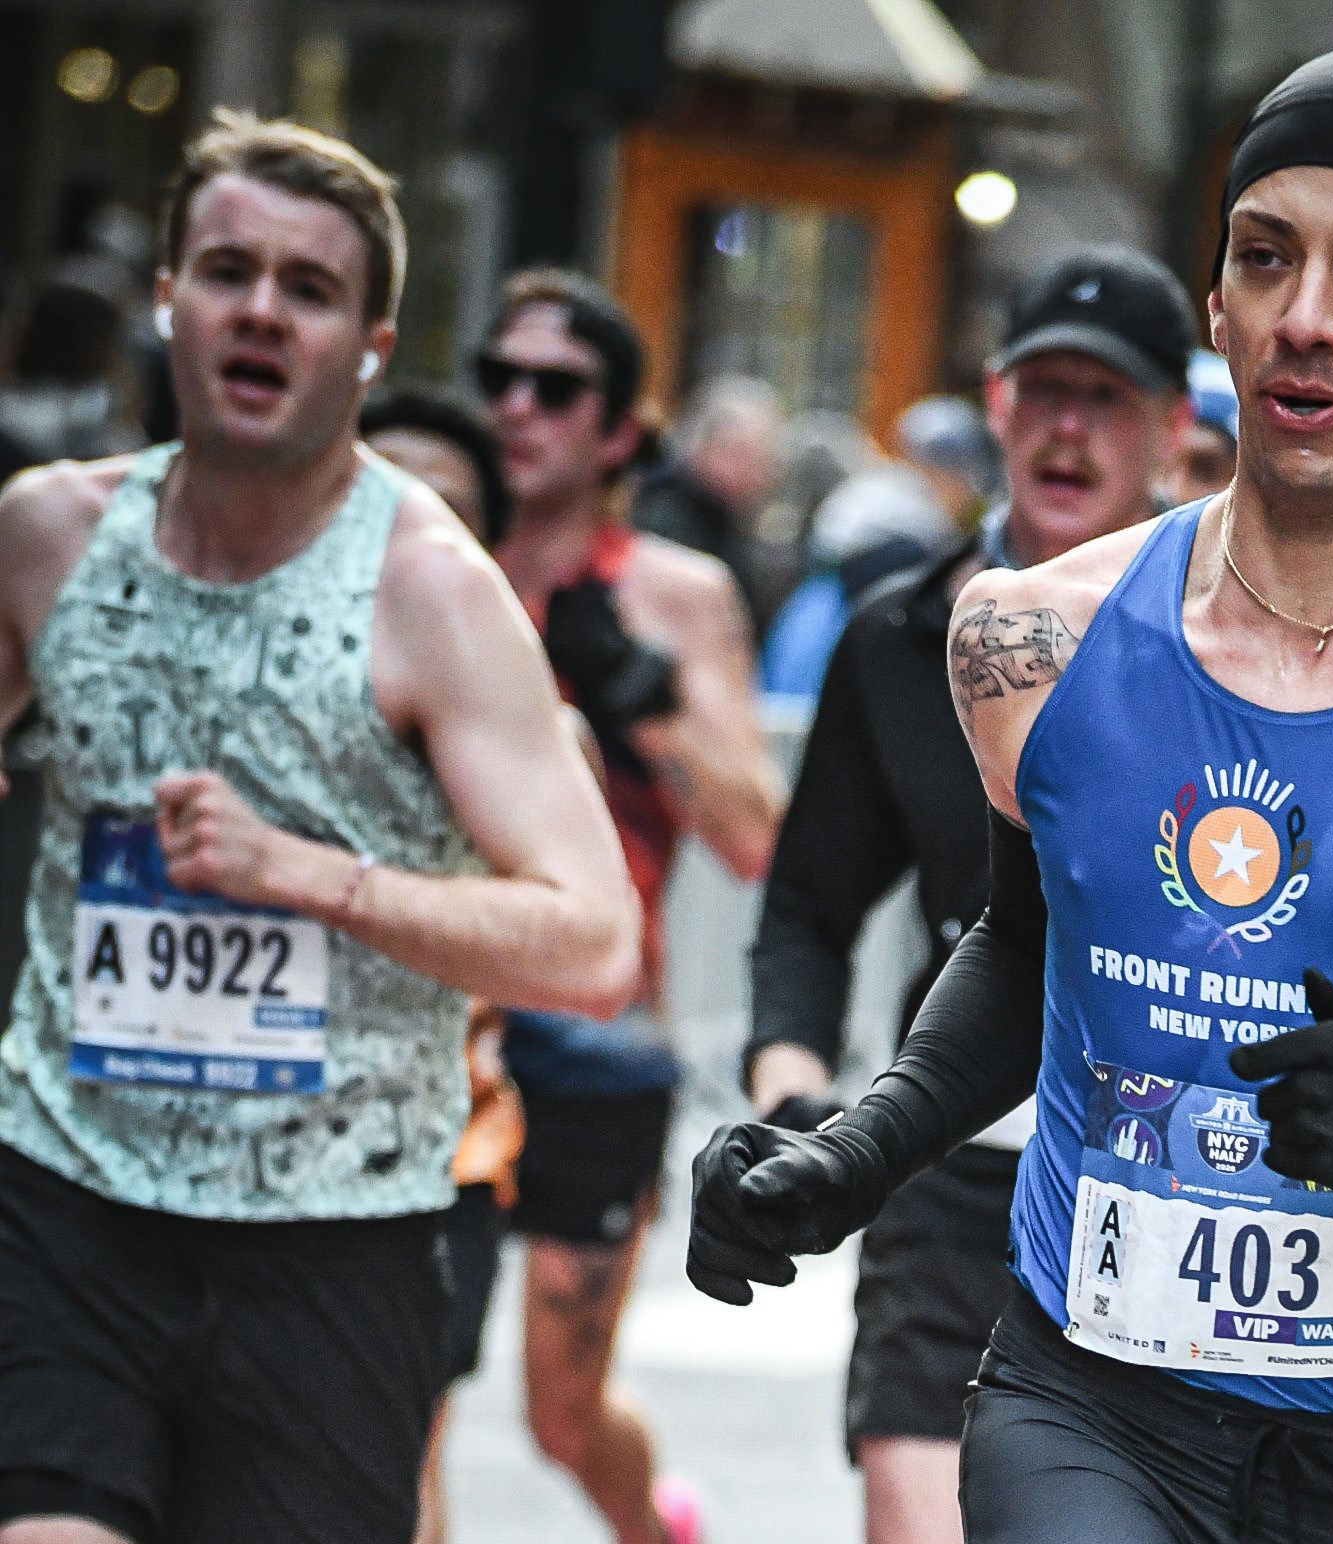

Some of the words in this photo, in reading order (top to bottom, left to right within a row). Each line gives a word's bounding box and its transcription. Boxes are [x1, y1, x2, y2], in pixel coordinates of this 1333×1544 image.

[86, 921, 126, 984] A
[149, 921, 293, 998] 9922
[1090, 945, 1192, 997] FRONT
[1149, 1004, 1212, 1040] NEW
[1207, 1130, 1250, 1153] NYC
[1208, 1147, 1246, 1164] HALF
[1100, 1200, 1121, 1239] A
[1097, 1240, 1119, 1279] A
[1178, 1217, 1321, 1312] 403
[1108, 1331, 1149, 1348] UNITED
[1233, 1315, 1280, 1340] VIP
